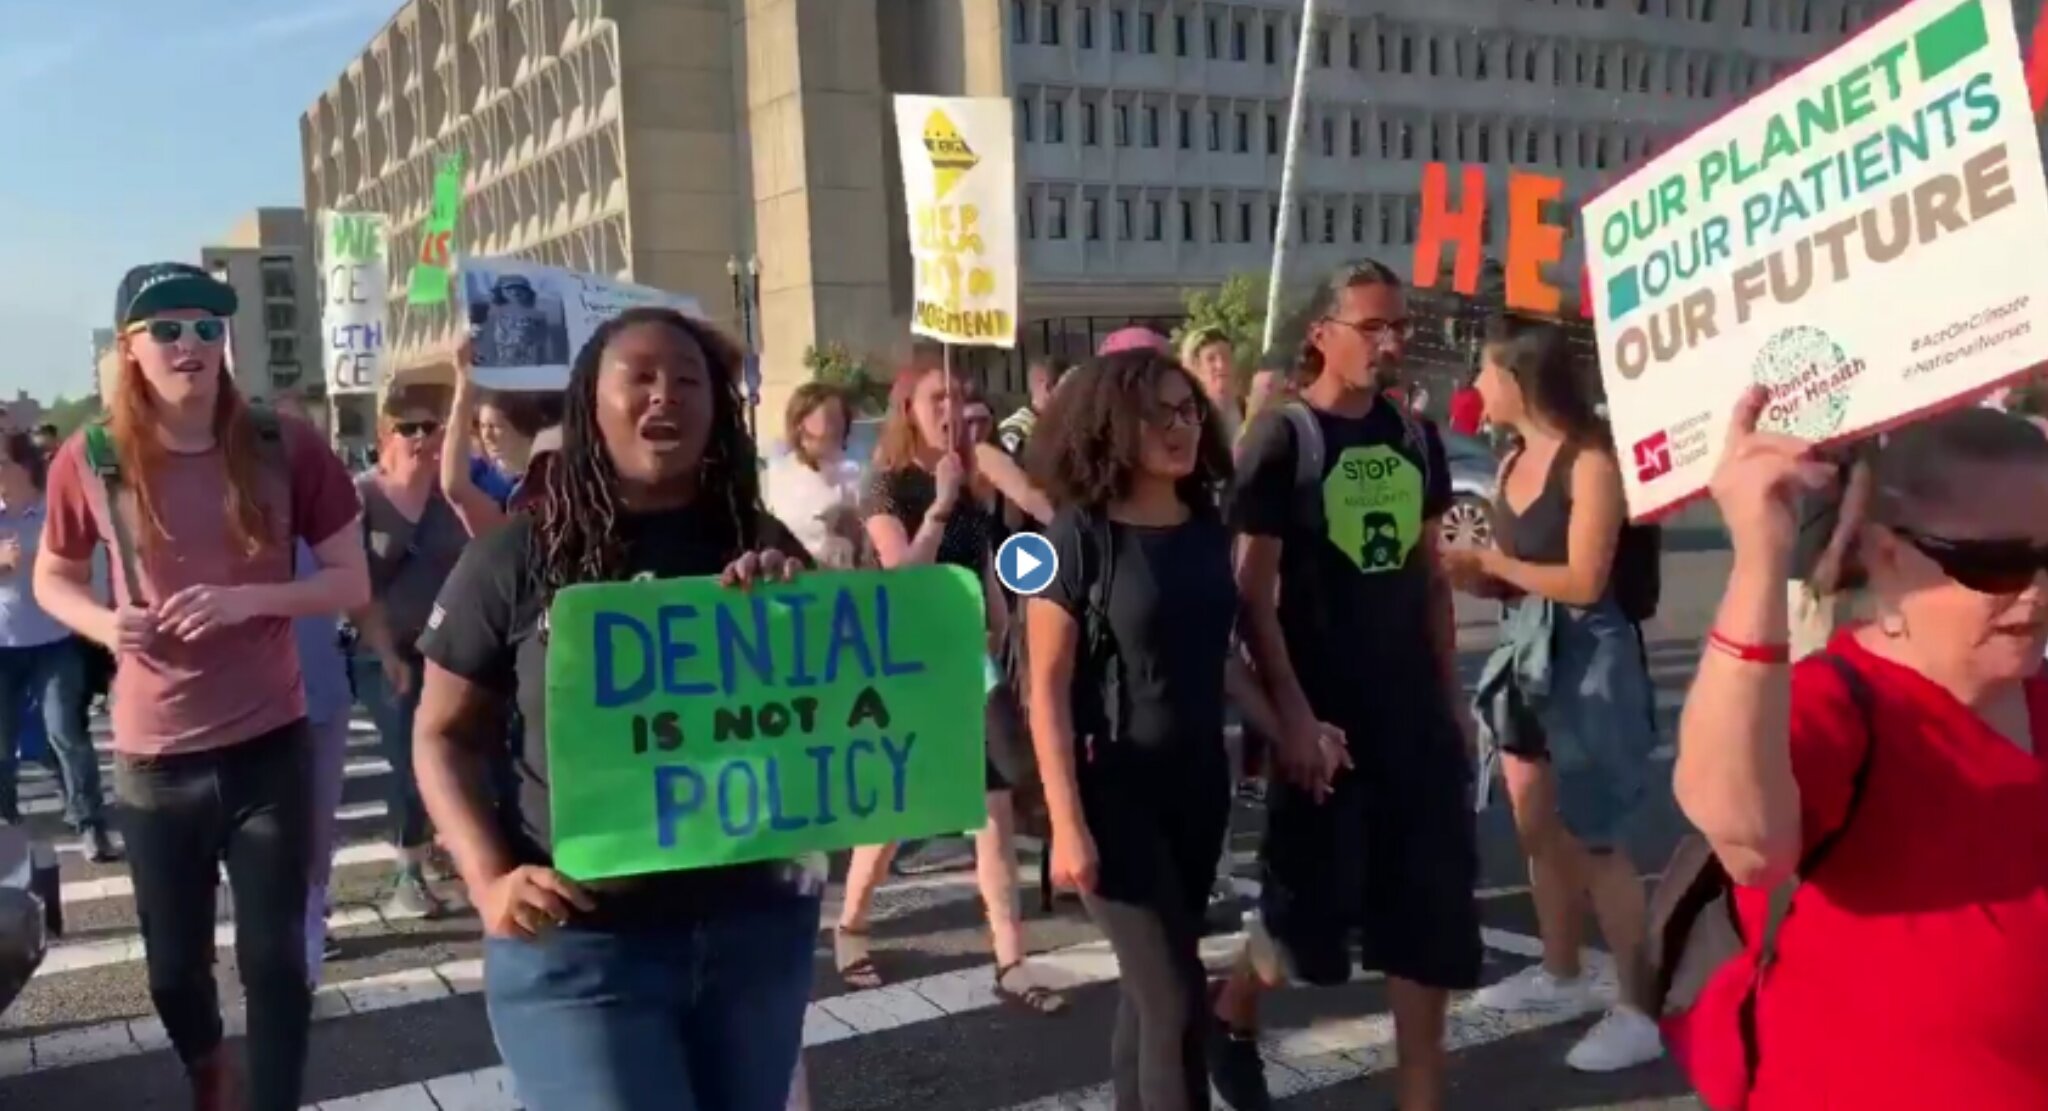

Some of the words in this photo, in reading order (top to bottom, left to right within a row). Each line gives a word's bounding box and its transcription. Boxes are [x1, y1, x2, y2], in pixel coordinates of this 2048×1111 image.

[1602, 173, 1687, 258] OUR
[1699, 41, 1909, 202] PLANET
[1642, 215, 1730, 297] OUR
[1742, 72, 2001, 246] PATIENTS
[1412, 162, 1593, 318] HE
[1615, 287, 1719, 380] OUR
[1732, 143, 2016, 324] FUTURE
[1770, 397, 1798, 421] Our
[1804, 357, 1866, 401] Health
[1342, 456, 1401, 481] STOP
[593, 584, 926, 708] DENIAL
[632, 710, 684, 754] IS
[713, 696, 819, 743] NOT
[846, 686, 891, 729] A
[654, 732, 916, 849] POLICY
